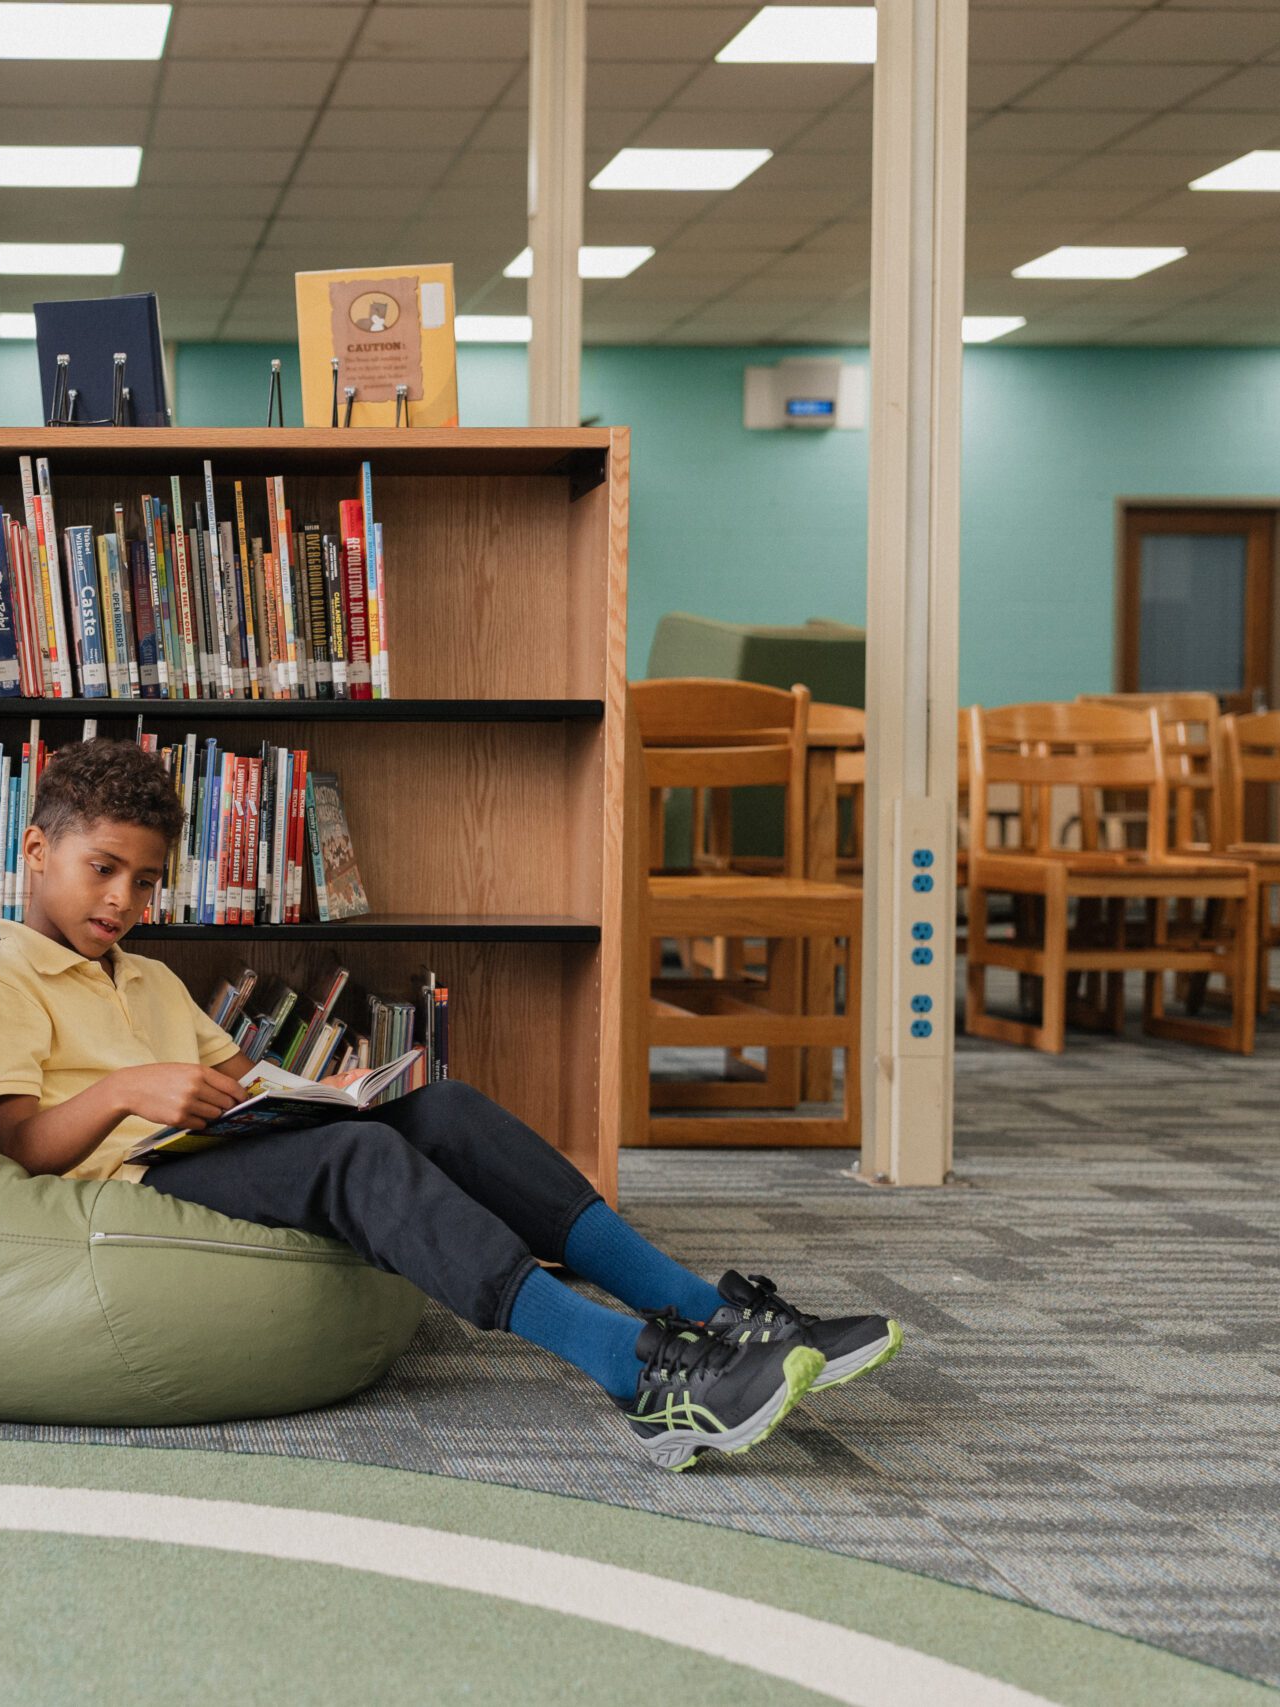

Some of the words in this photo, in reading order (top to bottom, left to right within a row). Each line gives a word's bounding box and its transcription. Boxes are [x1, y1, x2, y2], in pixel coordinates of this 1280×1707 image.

[76, 532, 84, 572] Wilkerson
[83, 528, 92, 555] Isabel
[176, 524, 184, 548] LOVE
[178, 551, 187, 589] AROUND
[305, 533, 324, 596] OVERGROUND
[346, 537, 363, 598] REVOLUTION
[80, 586, 95, 636] Caste
[311, 599, 327, 646] RAILROAD
[350, 601, 364, 614] IN
[115, 613, 124, 647] BORDERS
[183, 610, 192, 645] WORLD
[351, 616, 366, 637] OUR
[232, 848, 241, 882] DISASTERS
